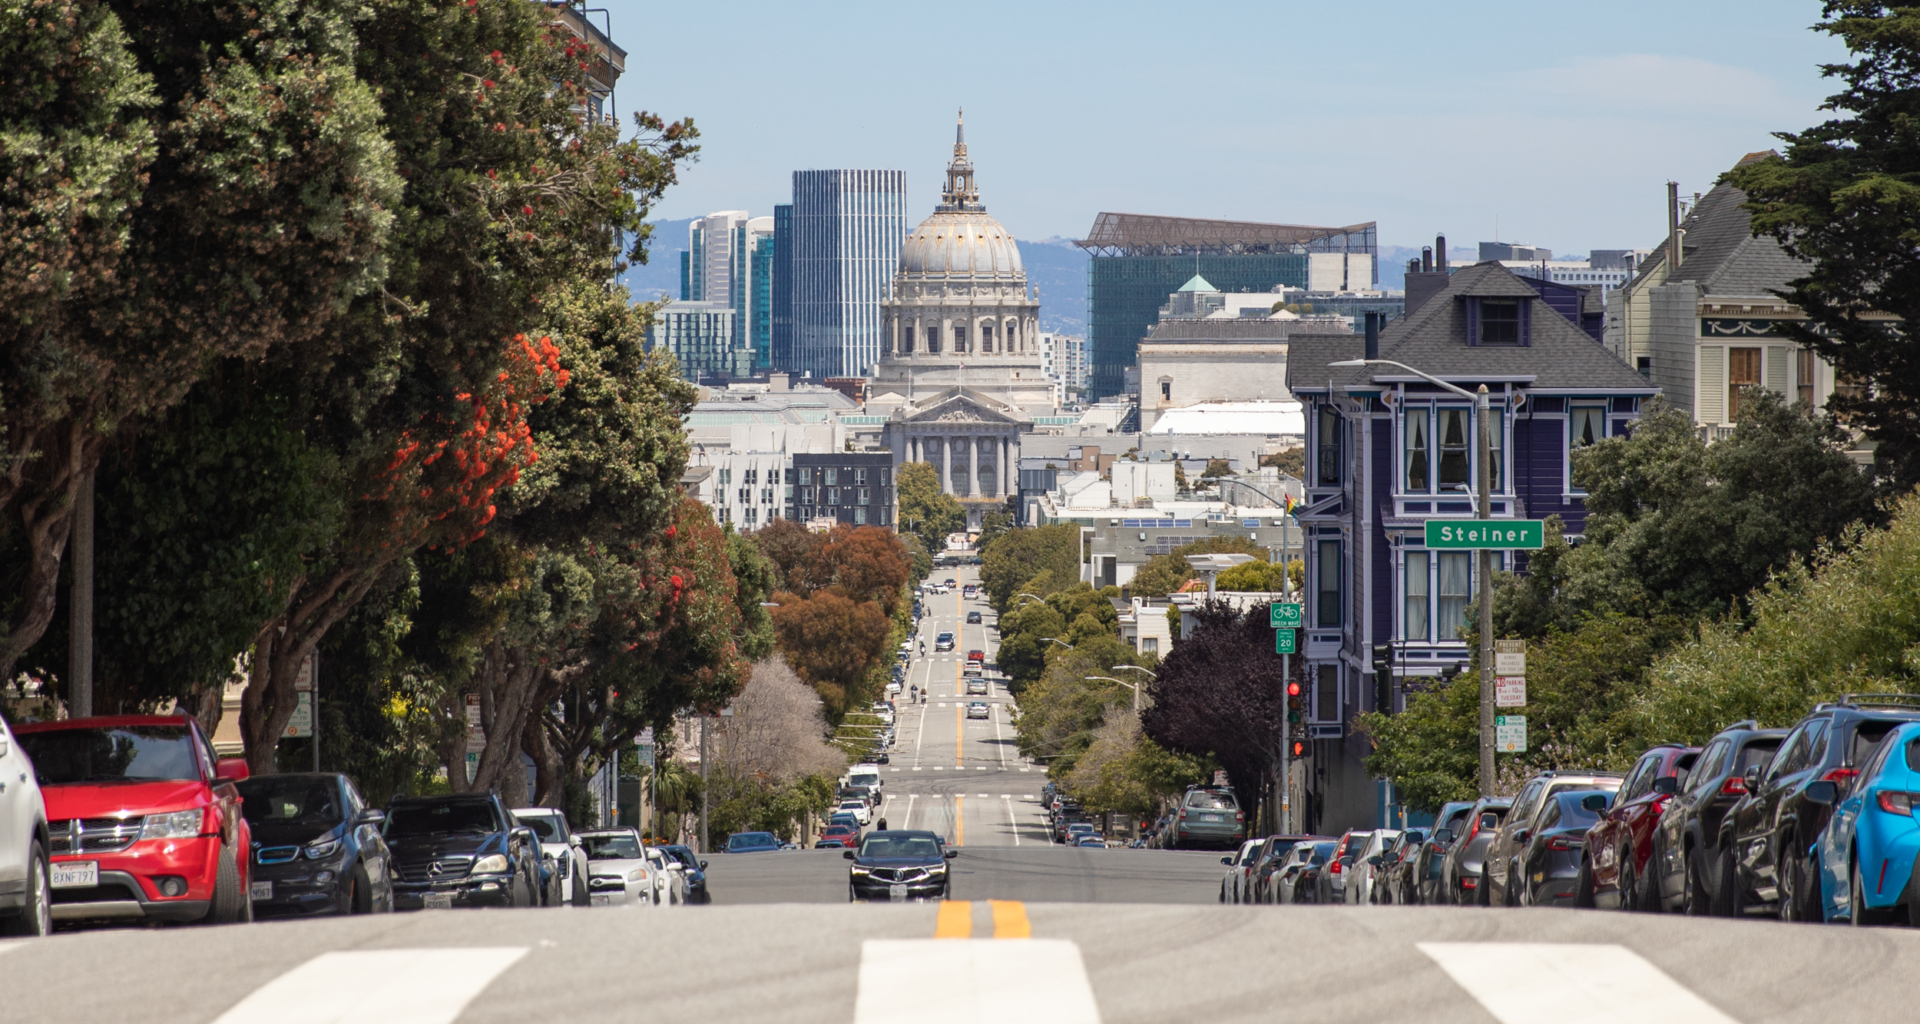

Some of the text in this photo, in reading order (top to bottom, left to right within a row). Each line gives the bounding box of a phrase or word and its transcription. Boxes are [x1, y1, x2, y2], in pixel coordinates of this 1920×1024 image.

[1440, 526, 1528, 541] Steiner
[1281, 639, 1291, 647] 20
[1497, 678, 1505, 686] NO
[1498, 717, 1504, 725] 2
[53, 871, 94, 884] 8XNF797
